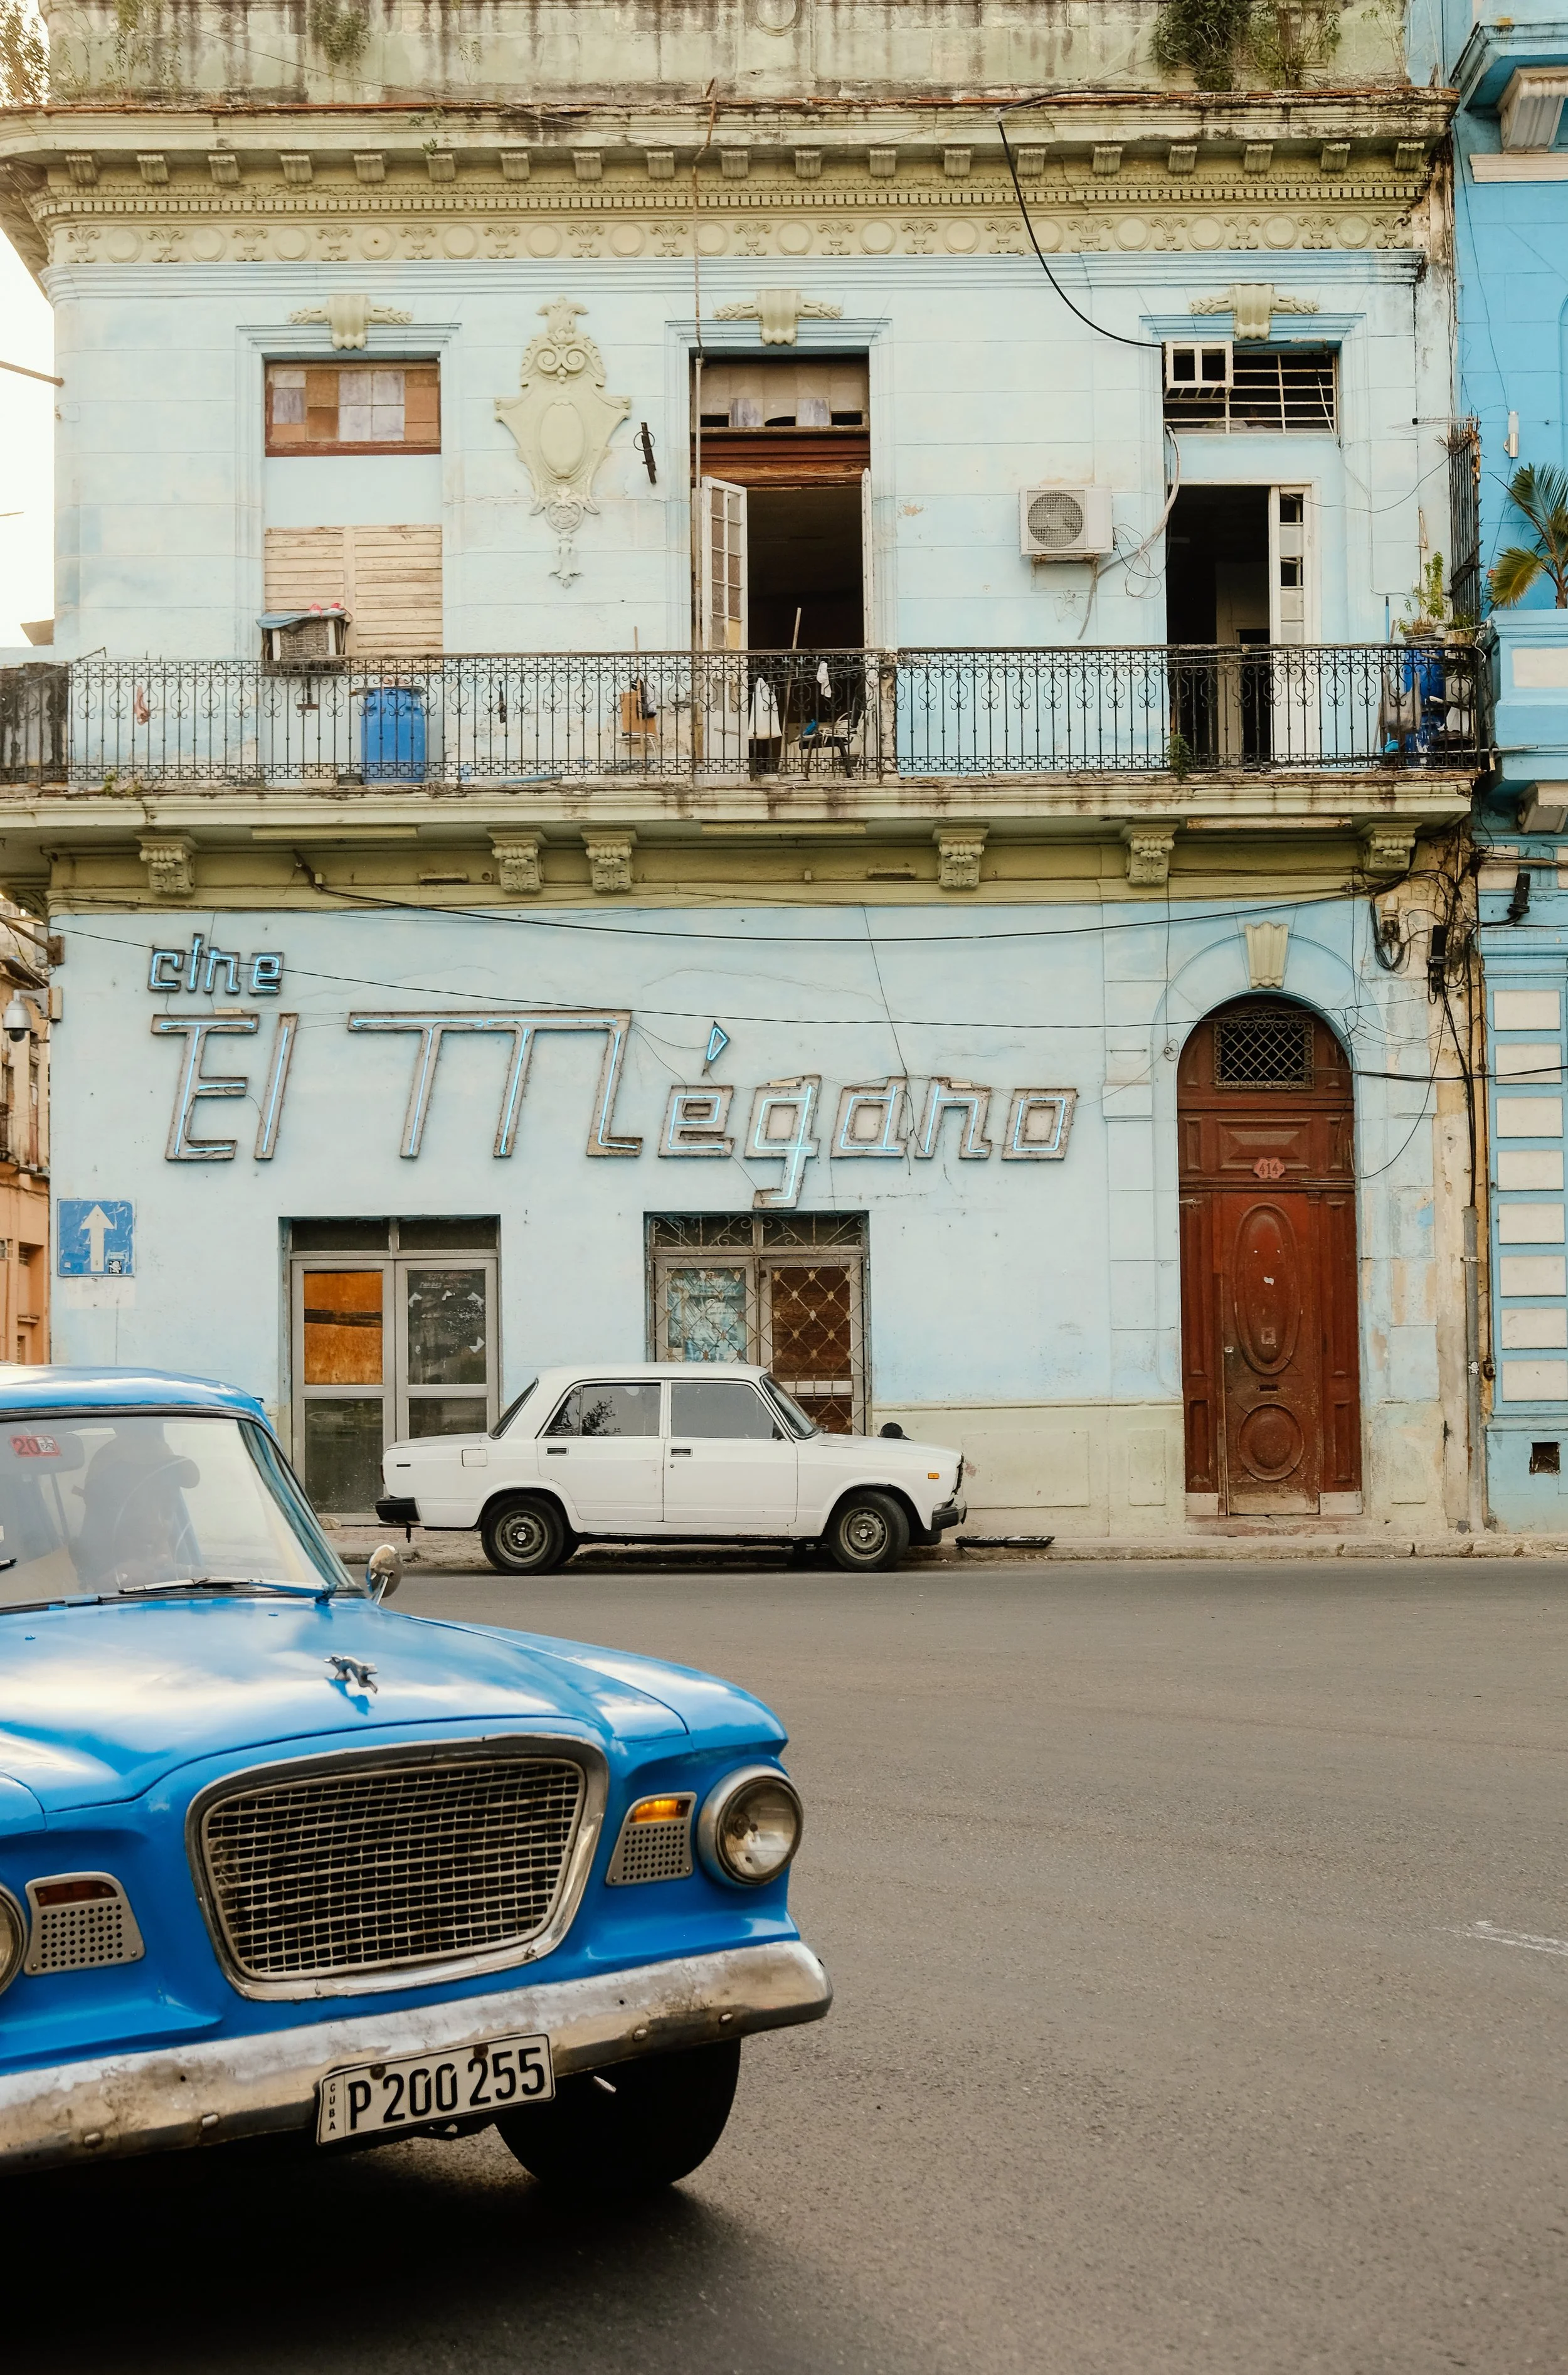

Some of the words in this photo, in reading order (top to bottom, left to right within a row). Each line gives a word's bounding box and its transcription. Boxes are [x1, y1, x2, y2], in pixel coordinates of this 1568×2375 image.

[147, 932, 285, 996] cine
[150, 1012, 299, 1161] El
[1259, 1162, 1279, 1175] 414
[328, 2083, 337, 2131] CUBA
